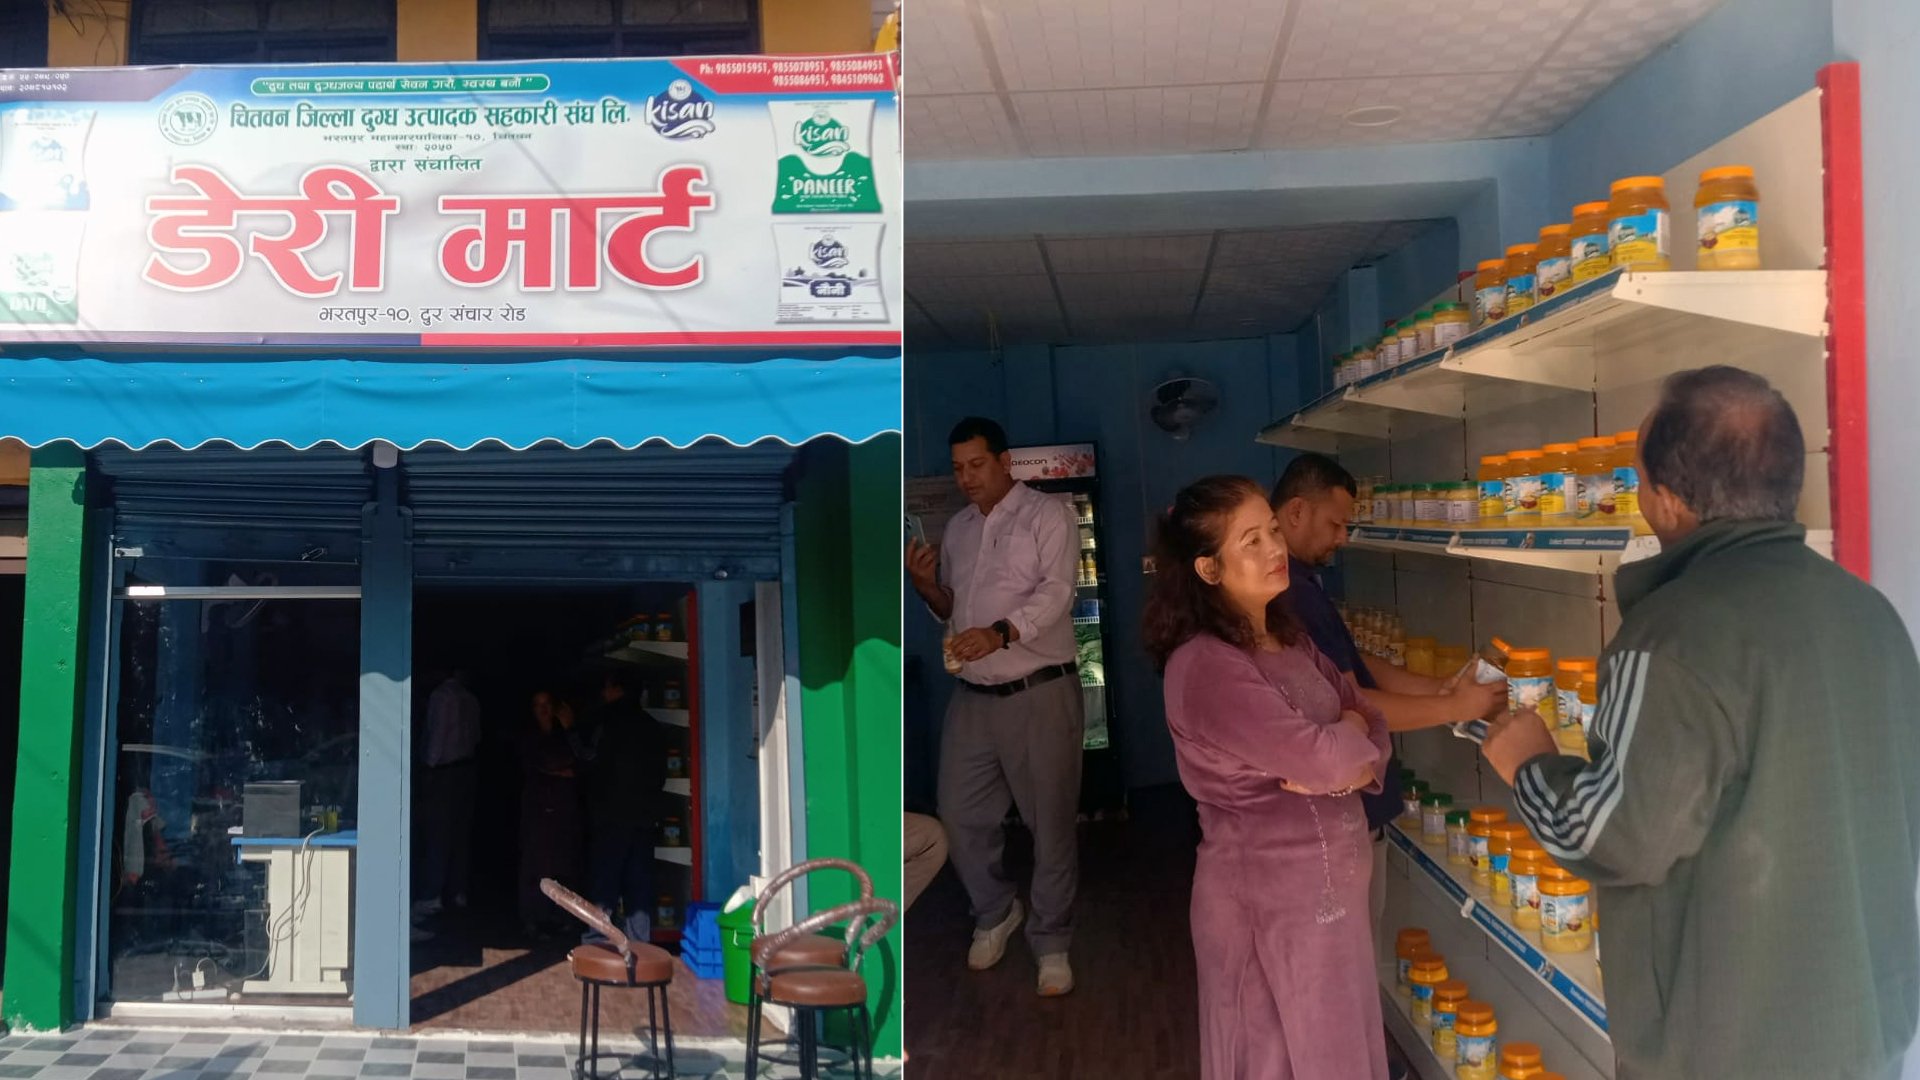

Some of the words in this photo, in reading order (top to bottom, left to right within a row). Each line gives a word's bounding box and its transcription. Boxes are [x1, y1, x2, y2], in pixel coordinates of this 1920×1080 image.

[700, 63, 713, 75] Ph:
[716, 62, 771, 75] 9855015951,
[773, 60, 829, 73] 9855078951,
[831, 59, 883, 71] 9855084951
[289, 80, 310, 91] तथा
[368, 78, 397, 90] पदार्थ
[400, 78, 428, 90] सेवन
[462, 79, 496, 89] स्वस्थ
[773, 74, 829, 87] 9855086951,
[831, 72, 885, 85] 9845109962
[230, 102, 291, 128] चितवन
[296, 102, 356, 128] जिल्ला
[361, 108, 400, 132] दुग्ध
[404, 106, 479, 127] उत्पादक
[484, 100, 559, 127] सहकारी
[564, 101, 596, 126] संघ
[601, 98, 631, 125] लि.
[370, 159, 406, 173] द्वारा
[414, 155, 483, 172] संचालित
[792, 178, 856, 195] PANEER
[144, 166, 398, 296] डेरी
[441, 166, 713, 290] मार्ट
[318, 306, 412, 326] भरतपुर-१०,
[450, 304, 494, 322] संचार
[499, 303, 528, 322] रोड
